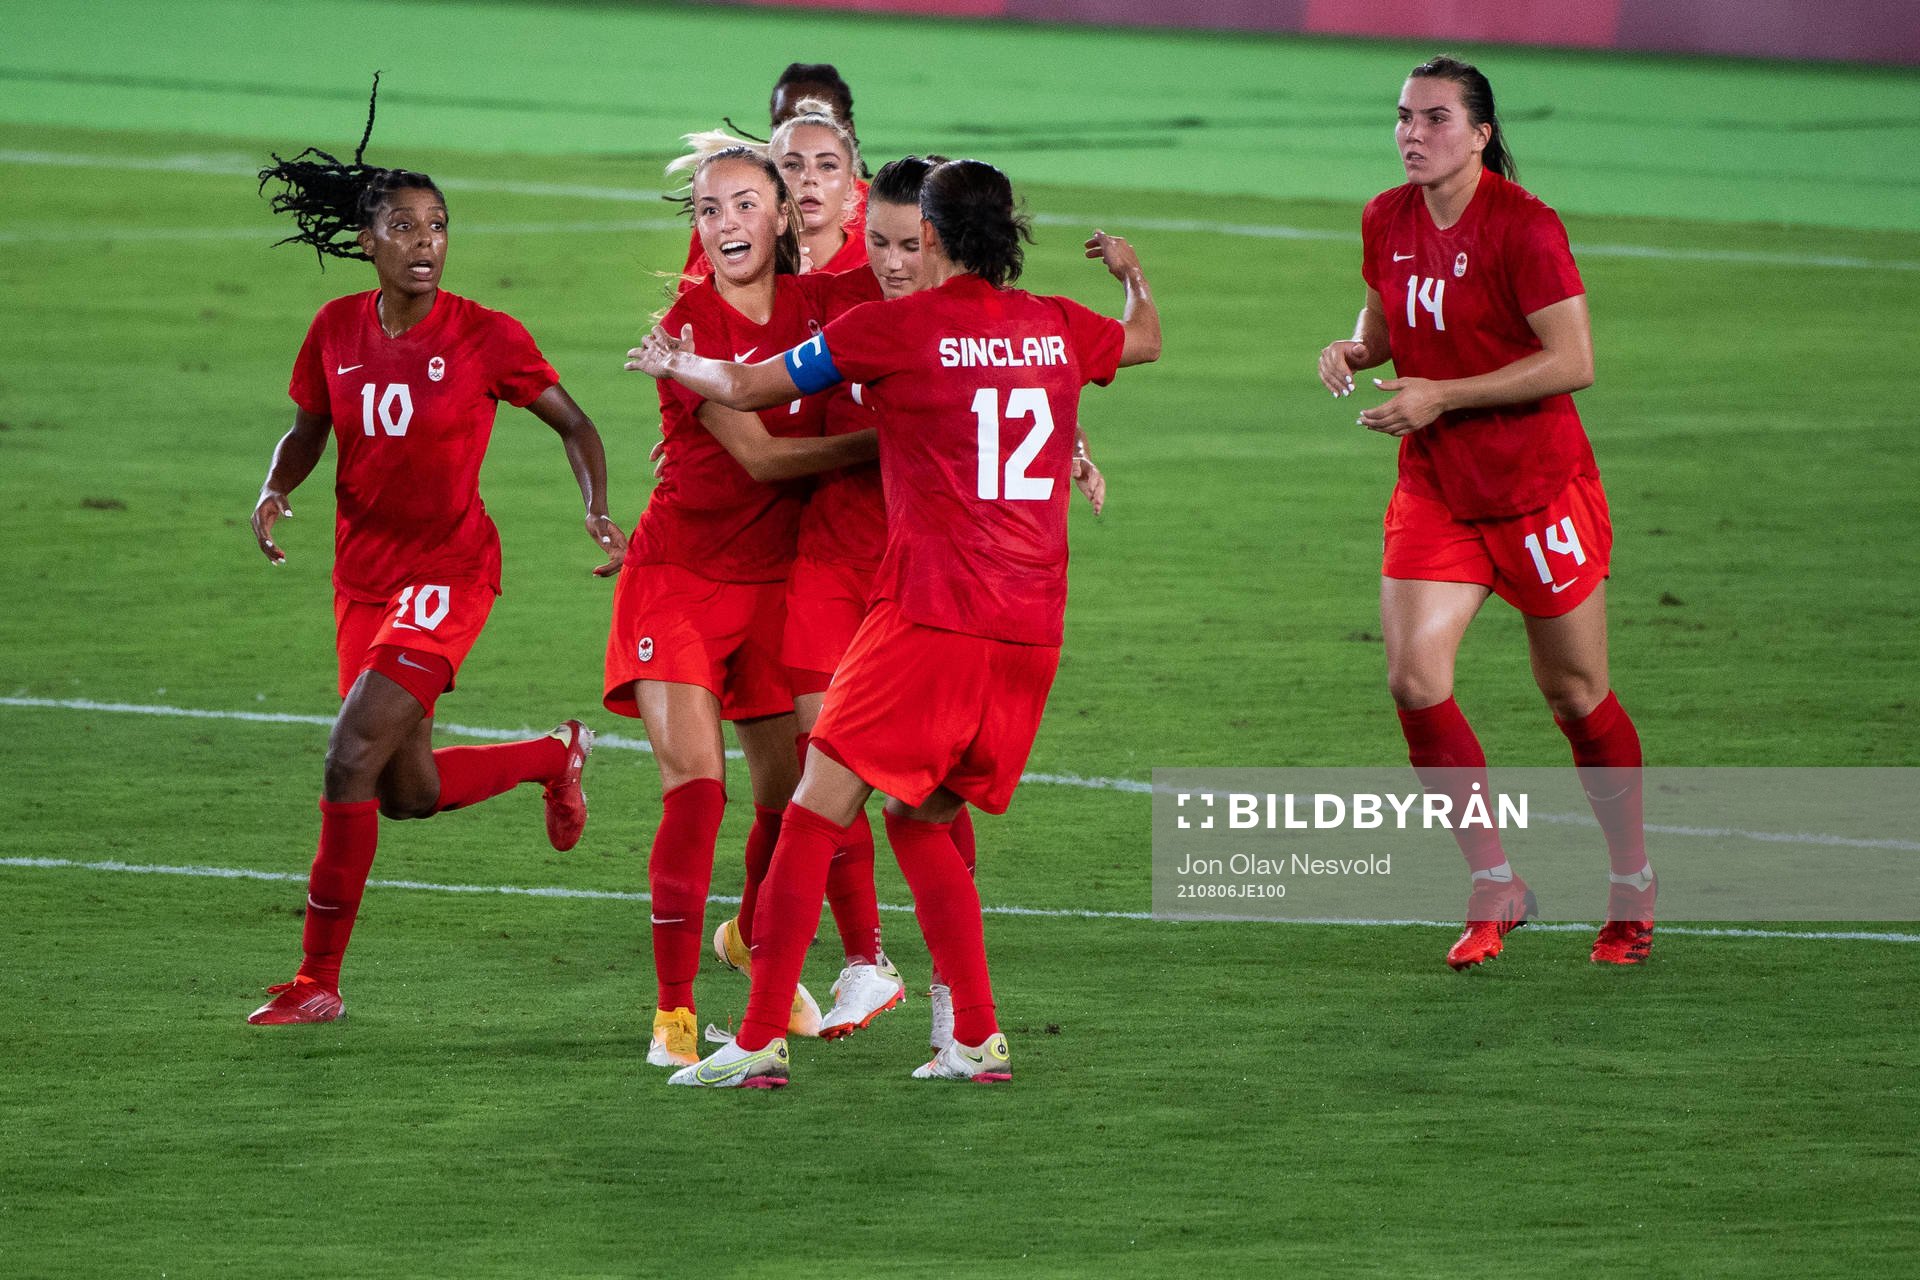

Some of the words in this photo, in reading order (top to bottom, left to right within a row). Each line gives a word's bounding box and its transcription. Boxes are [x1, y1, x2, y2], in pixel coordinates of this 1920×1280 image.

[1407, 275, 1445, 331] 14
[938, 335, 1068, 367] SINCLAIR
[361, 383, 414, 437] 10
[970, 387, 1055, 501] 12
[1524, 516, 1586, 584] 14
[396, 584, 450, 631] 10
